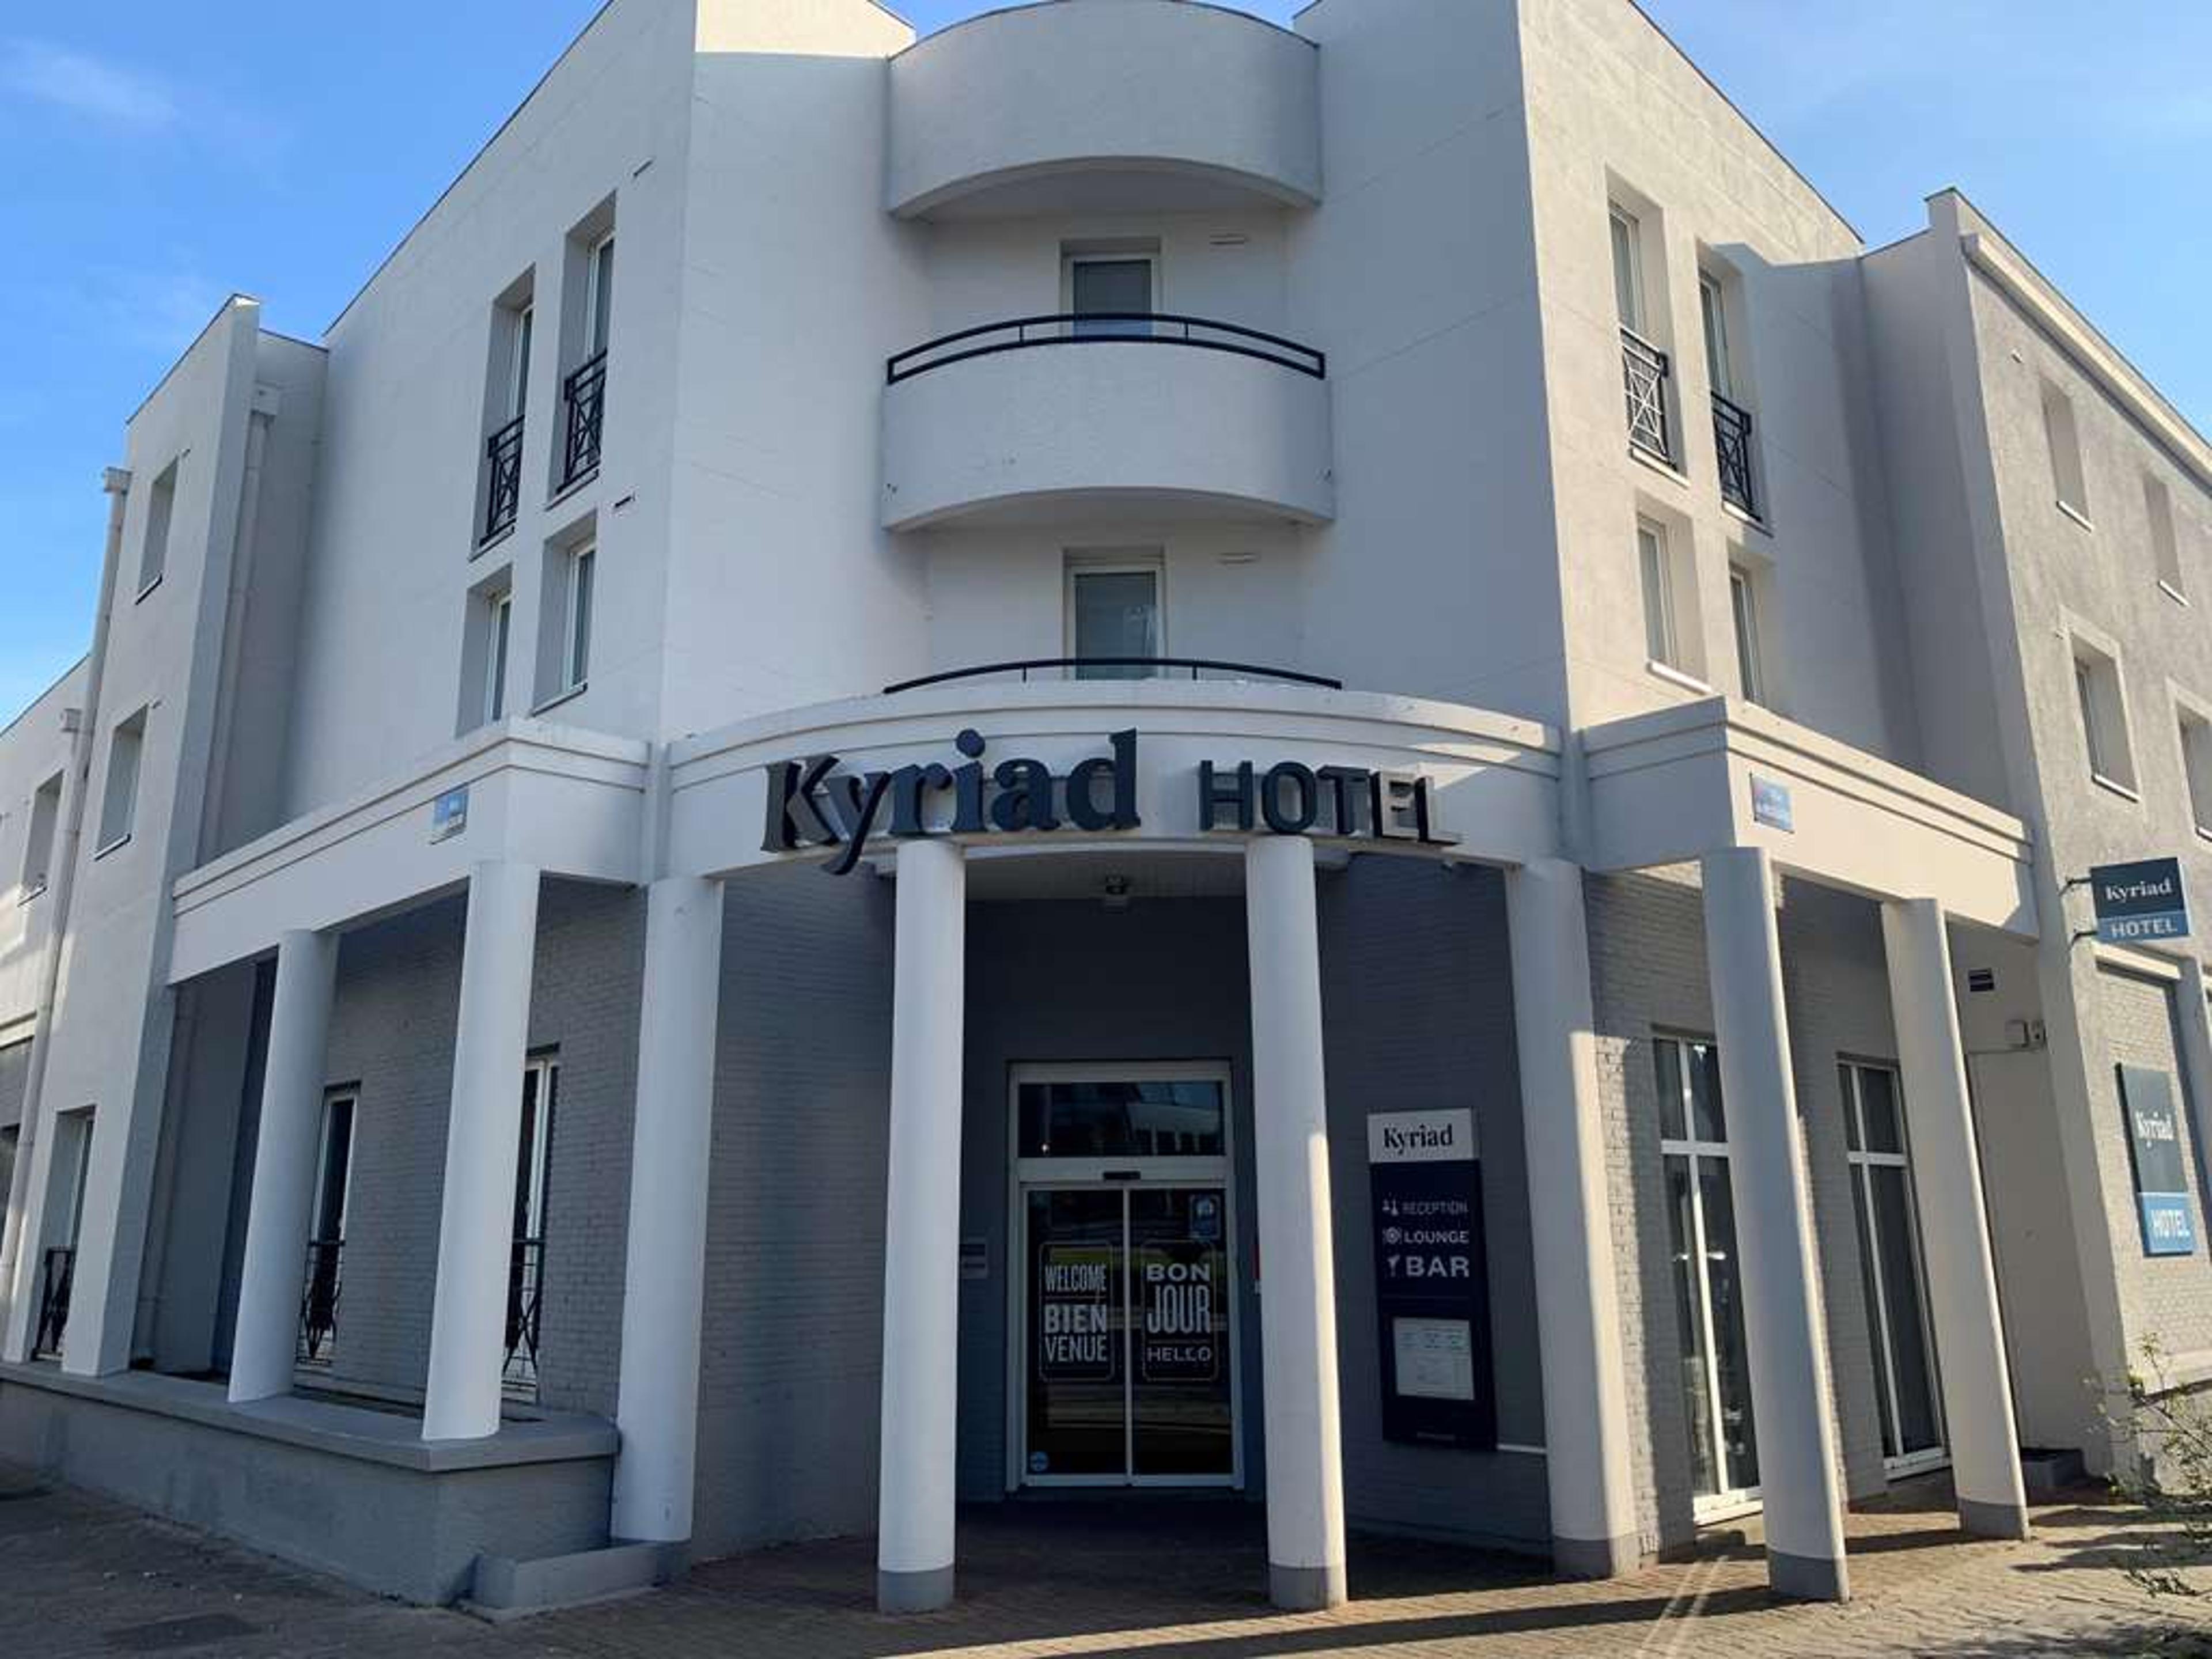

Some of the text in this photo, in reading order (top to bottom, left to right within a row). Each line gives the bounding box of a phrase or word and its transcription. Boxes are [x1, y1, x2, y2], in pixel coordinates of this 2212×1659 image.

[762, 728, 1461, 875] Kyriad HOTEL
[2106, 877, 2172, 903] Kyriad
[2111, 918, 2177, 938] HOTEL
[1384, 1124, 1453, 1154] Kyriad
[2135, 1111, 2173, 1148] Kyriad
[1402, 1200, 1469, 1215] RECEPTION
[2151, 1209, 2191, 1237] HOTEL
[1403, 1230, 1469, 1244] LOUNGE
[1044, 1264, 1107, 1292] WELCOME
[1146, 1263, 1210, 1282] BON
[1405, 1255, 1469, 1278] BAR
[1044, 1304, 1107, 1334] BIEN
[1146, 1283, 1211, 1334] JOUR
[1044, 1335, 1107, 1362] VENUE
